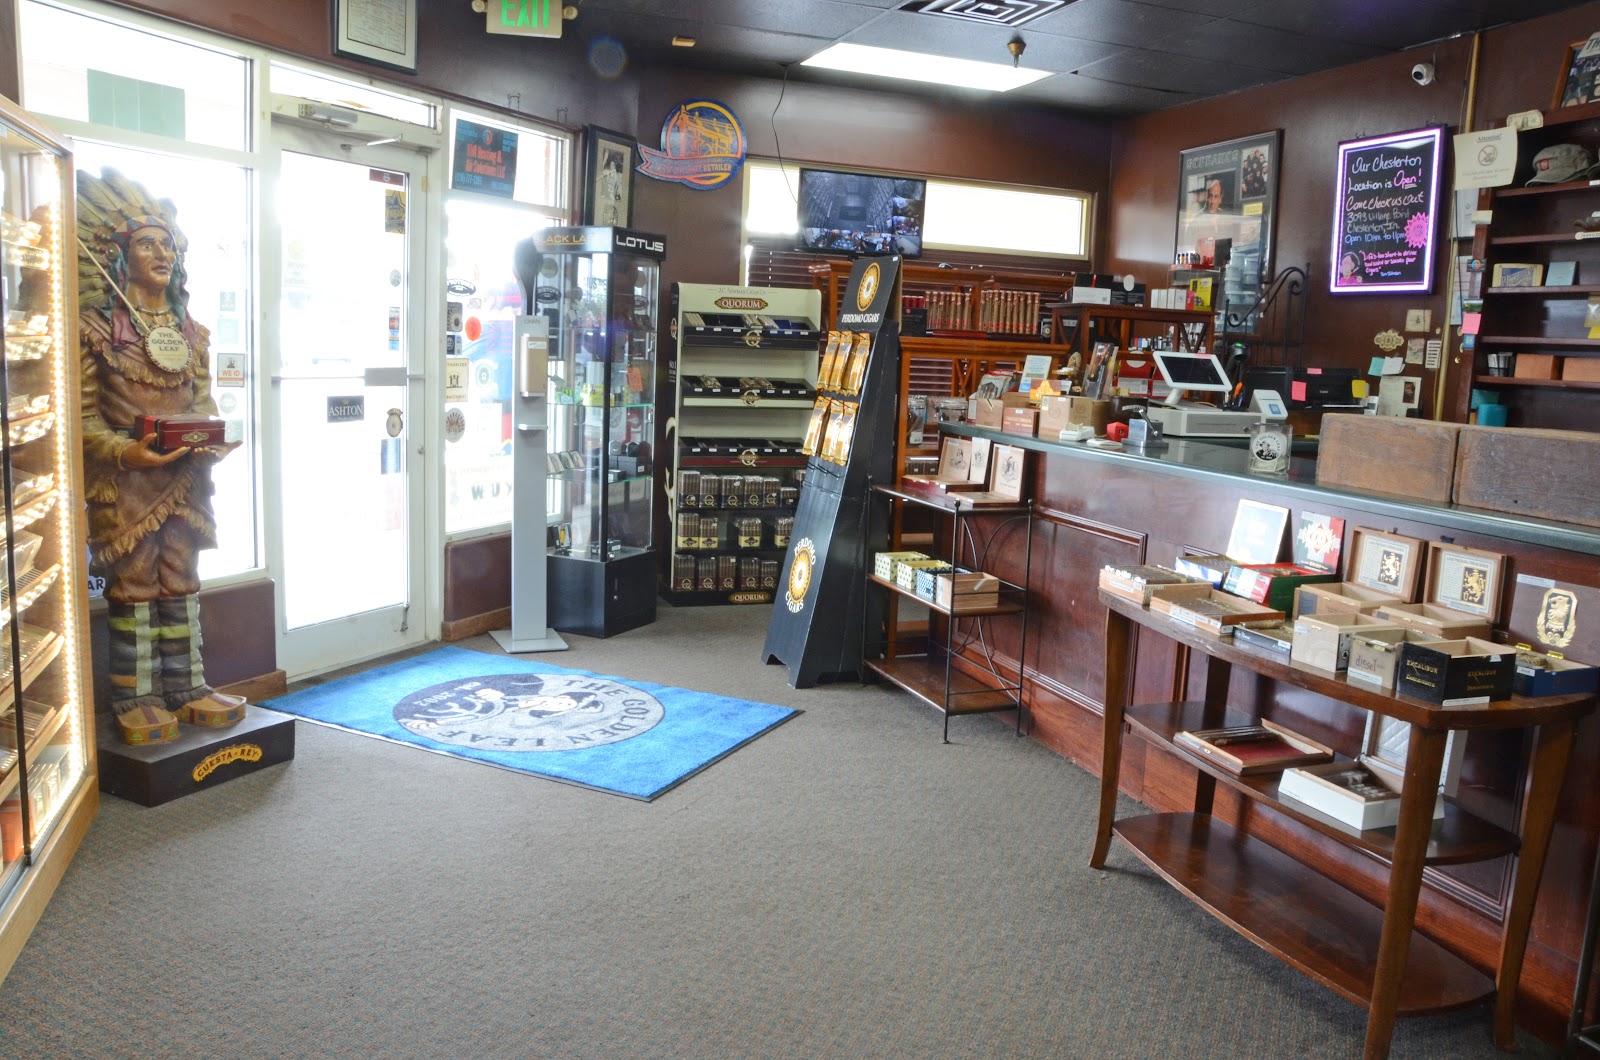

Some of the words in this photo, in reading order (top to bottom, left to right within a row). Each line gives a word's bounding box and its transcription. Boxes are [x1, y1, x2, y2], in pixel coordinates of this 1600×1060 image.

[501, 0, 549, 28] EXIT
[703, 163, 732, 172] RETAILER
[1352, 157, 1370, 174] Our
[1372, 153, 1422, 171] Chesterton
[1347, 177, 1382, 194] Location
[1385, 179, 1392, 188] is
[1391, 197, 1402, 206] us
[616, 234, 664, 252] LOTUS
[1344, 234, 1361, 245] Open
[1383, 232, 1391, 240] to
[721, 299, 760, 309] QUORUM
[841, 313, 863, 323] PERDOMO
[863, 313, 880, 323] CIGARS
[328, 404, 363, 417] ASHTON
[794, 537, 816, 565] PERDOMO
[88, 578, 104, 591] AR
[735, 594, 765, 602] QUORUM
[785, 591, 804, 613] CIGARS
[1356, 655, 1377, 672] diesel
[1406, 659, 1438, 674] EXCALIBUR
[563, 680, 622, 696] THE
[566, 699, 650, 746] GOLDEN
[438, 729, 547, 748] LEAF
